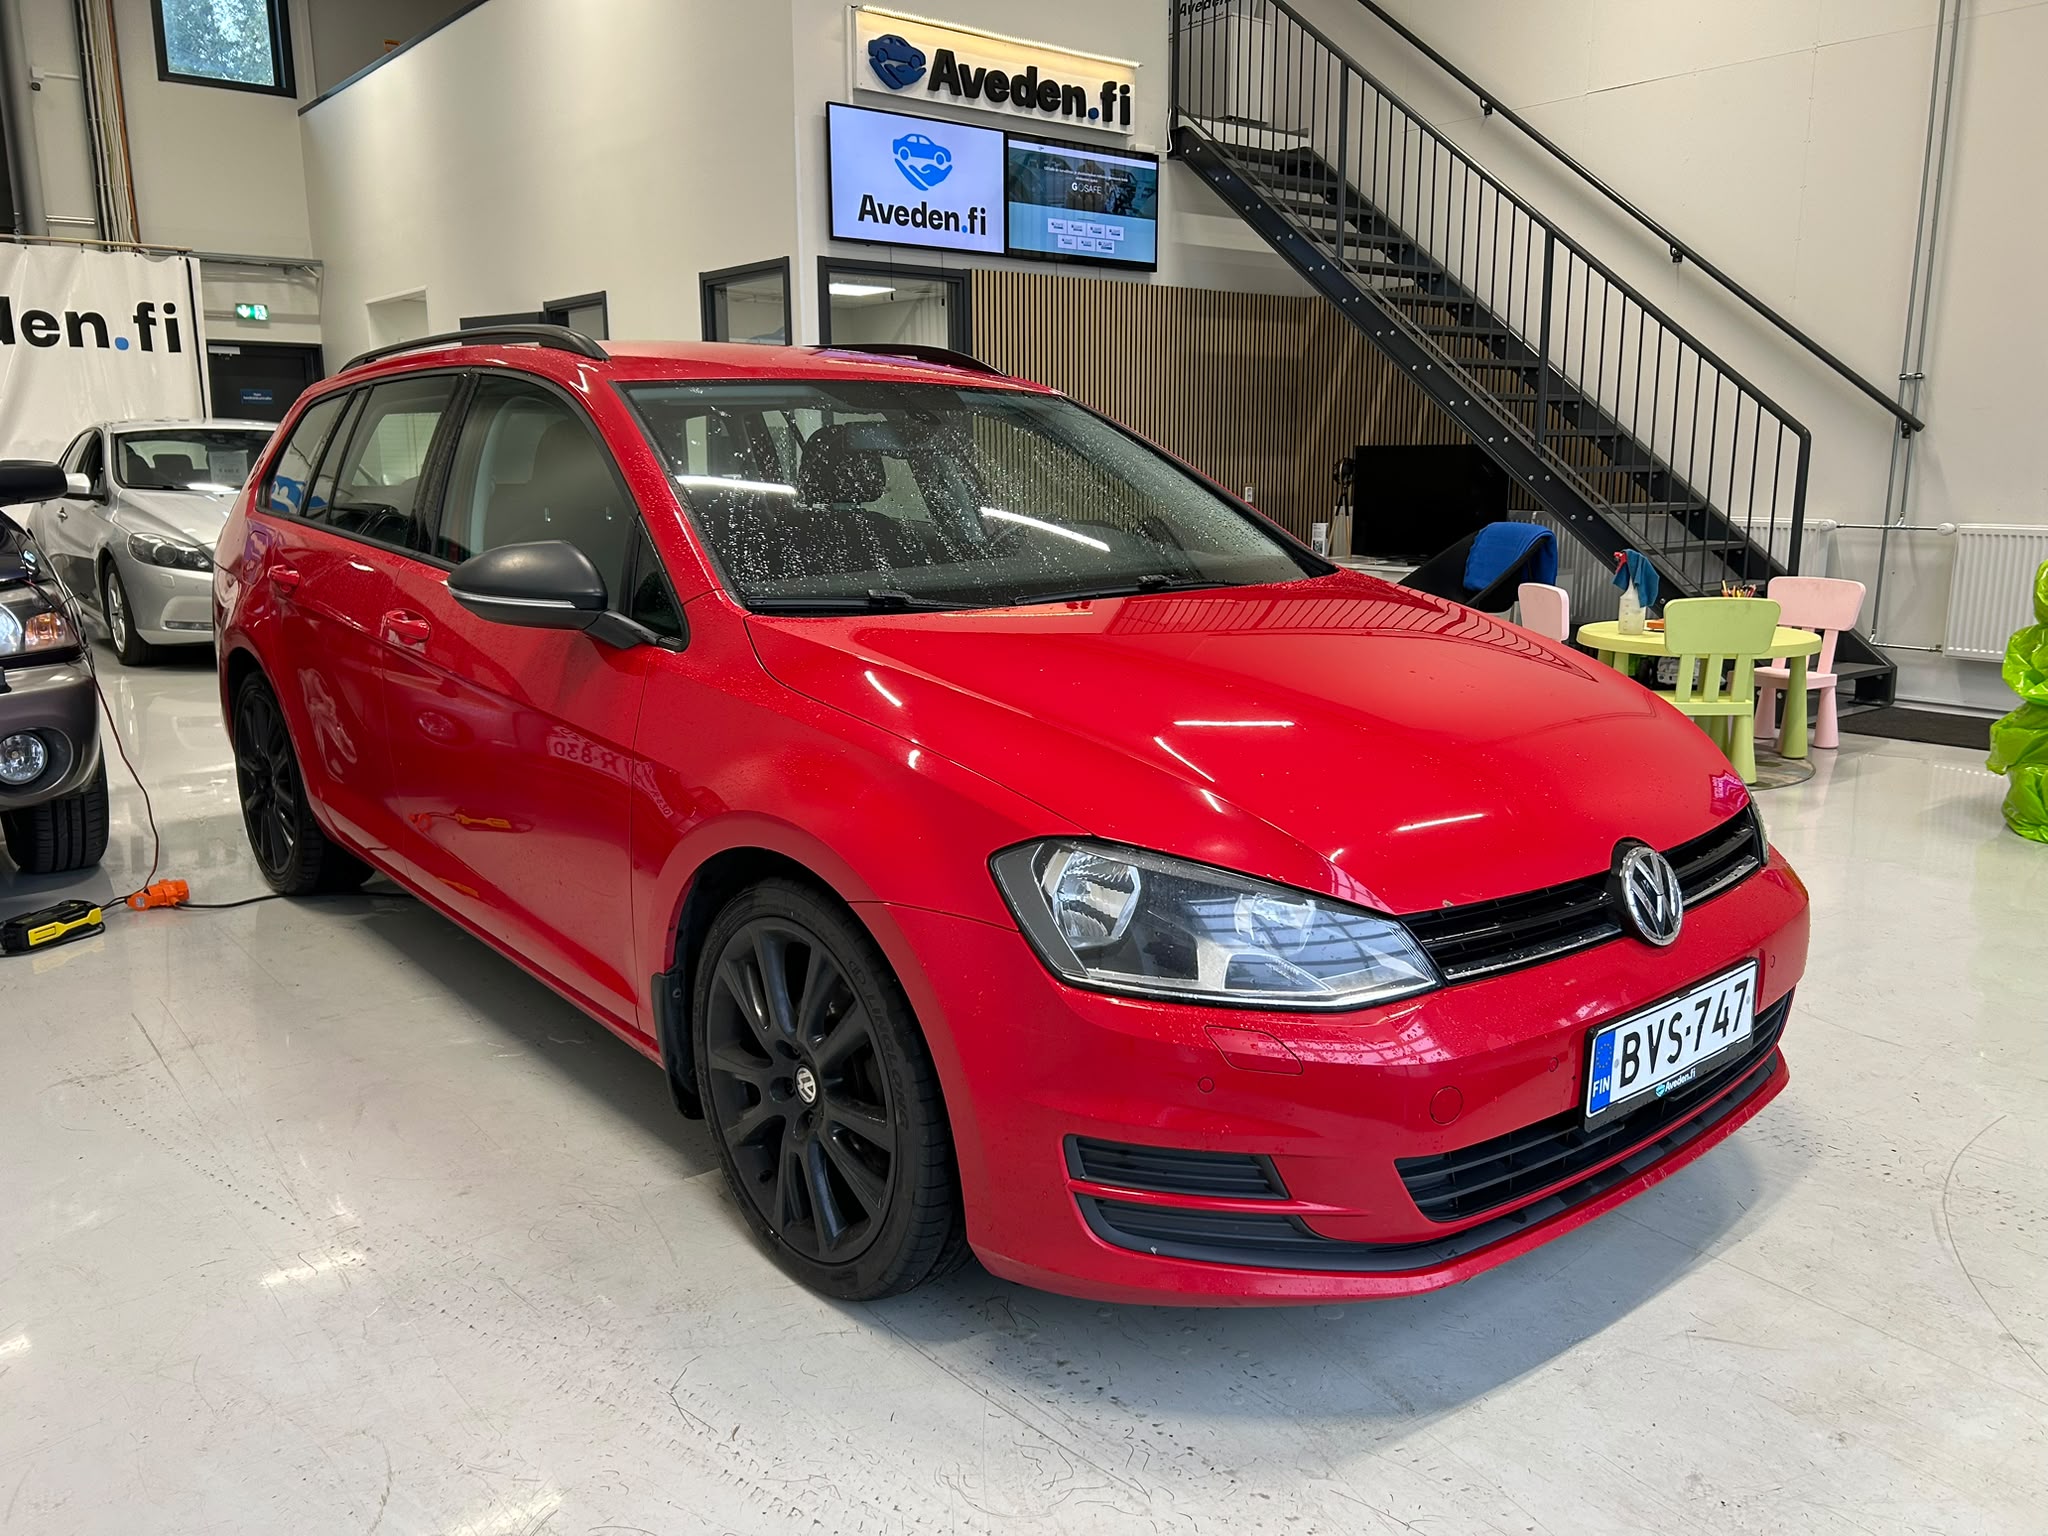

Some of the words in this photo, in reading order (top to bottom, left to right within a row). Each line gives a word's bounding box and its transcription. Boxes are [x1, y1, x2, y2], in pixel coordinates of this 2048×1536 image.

[927, 48, 1131, 126] Aveden.fi
[858, 194, 986, 236] Aveden.fi
[1619, 978, 1749, 1089] BVS-747
[1592, 1075, 1611, 1098] FIN
[1665, 1067, 1696, 1092] Aveden.fi
